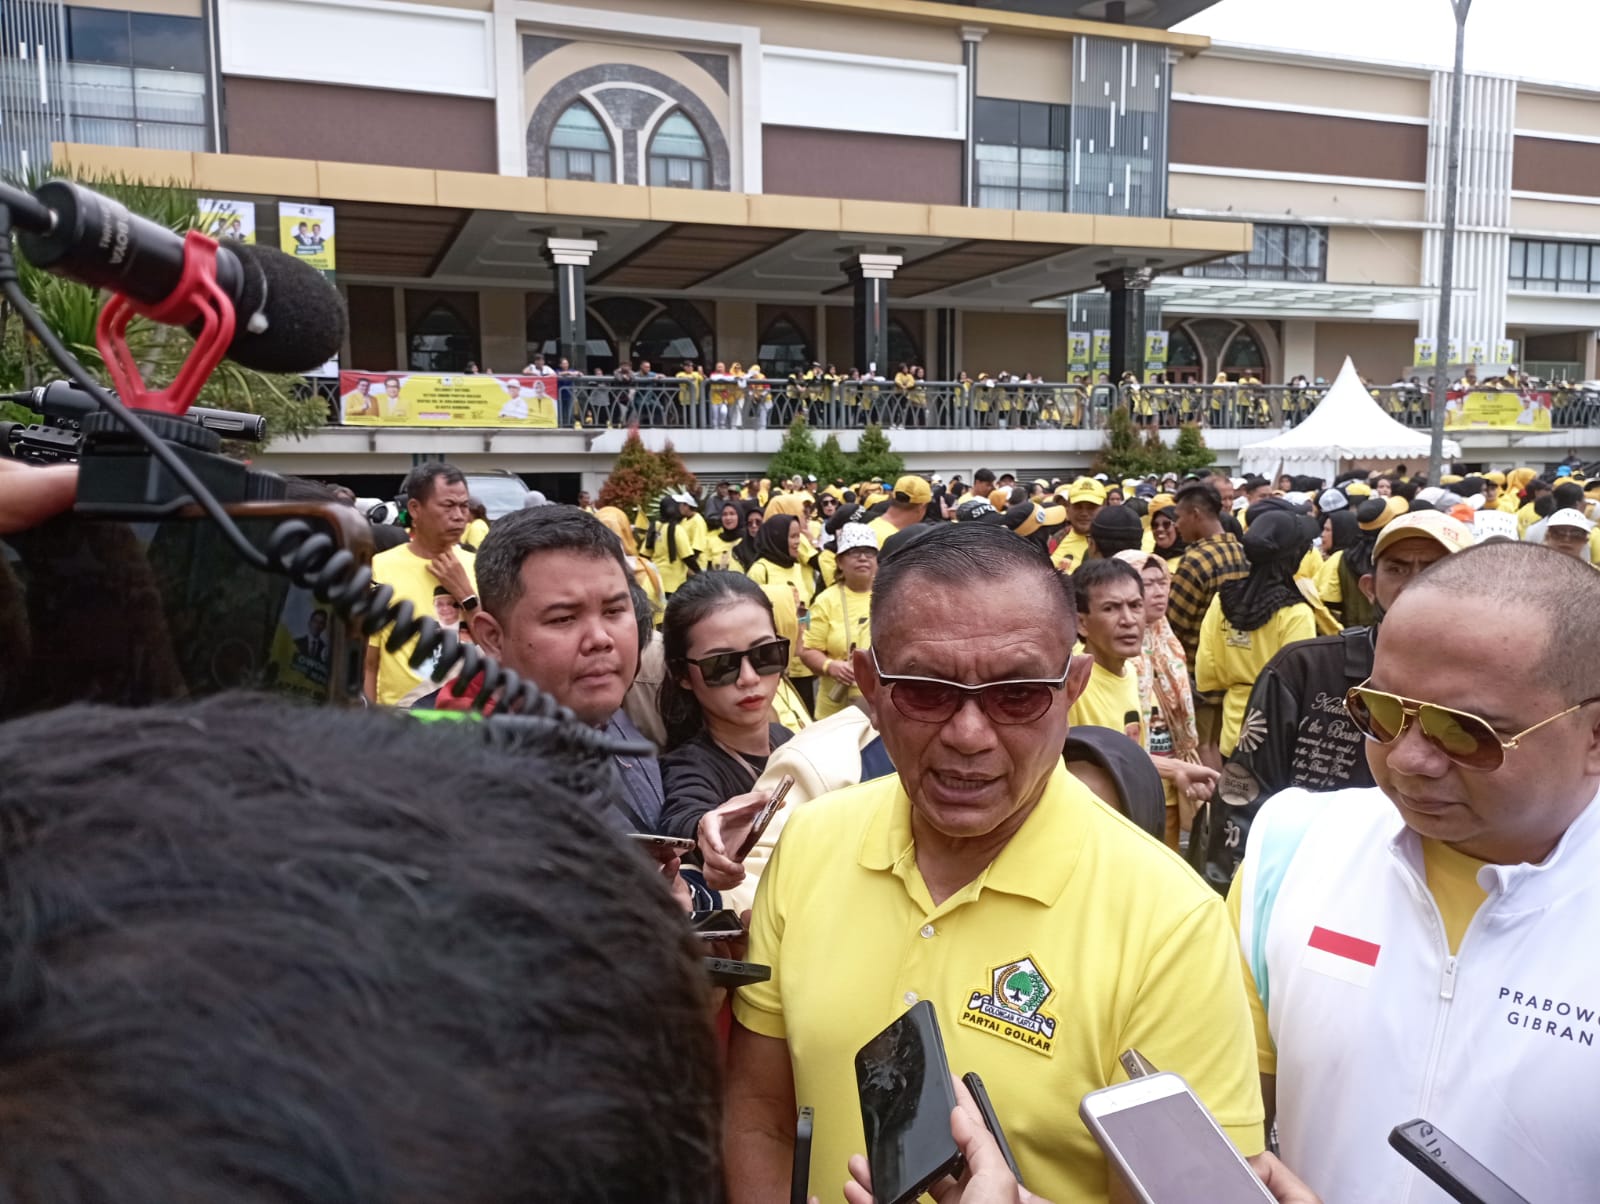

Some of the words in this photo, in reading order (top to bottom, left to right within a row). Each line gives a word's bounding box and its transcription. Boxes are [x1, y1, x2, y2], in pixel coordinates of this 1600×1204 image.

[109, 221, 129, 264] BOYA
[984, 1004, 1015, 1022] GOLONGAN
[1015, 1015, 1036, 1030] KARYA
[1498, 986, 1600, 1026] PRABOW
[962, 1011, 1000, 1032] PARTAI
[1004, 1027, 1051, 1052] GOLKAR
[1507, 1011, 1594, 1046] GIBRAN
